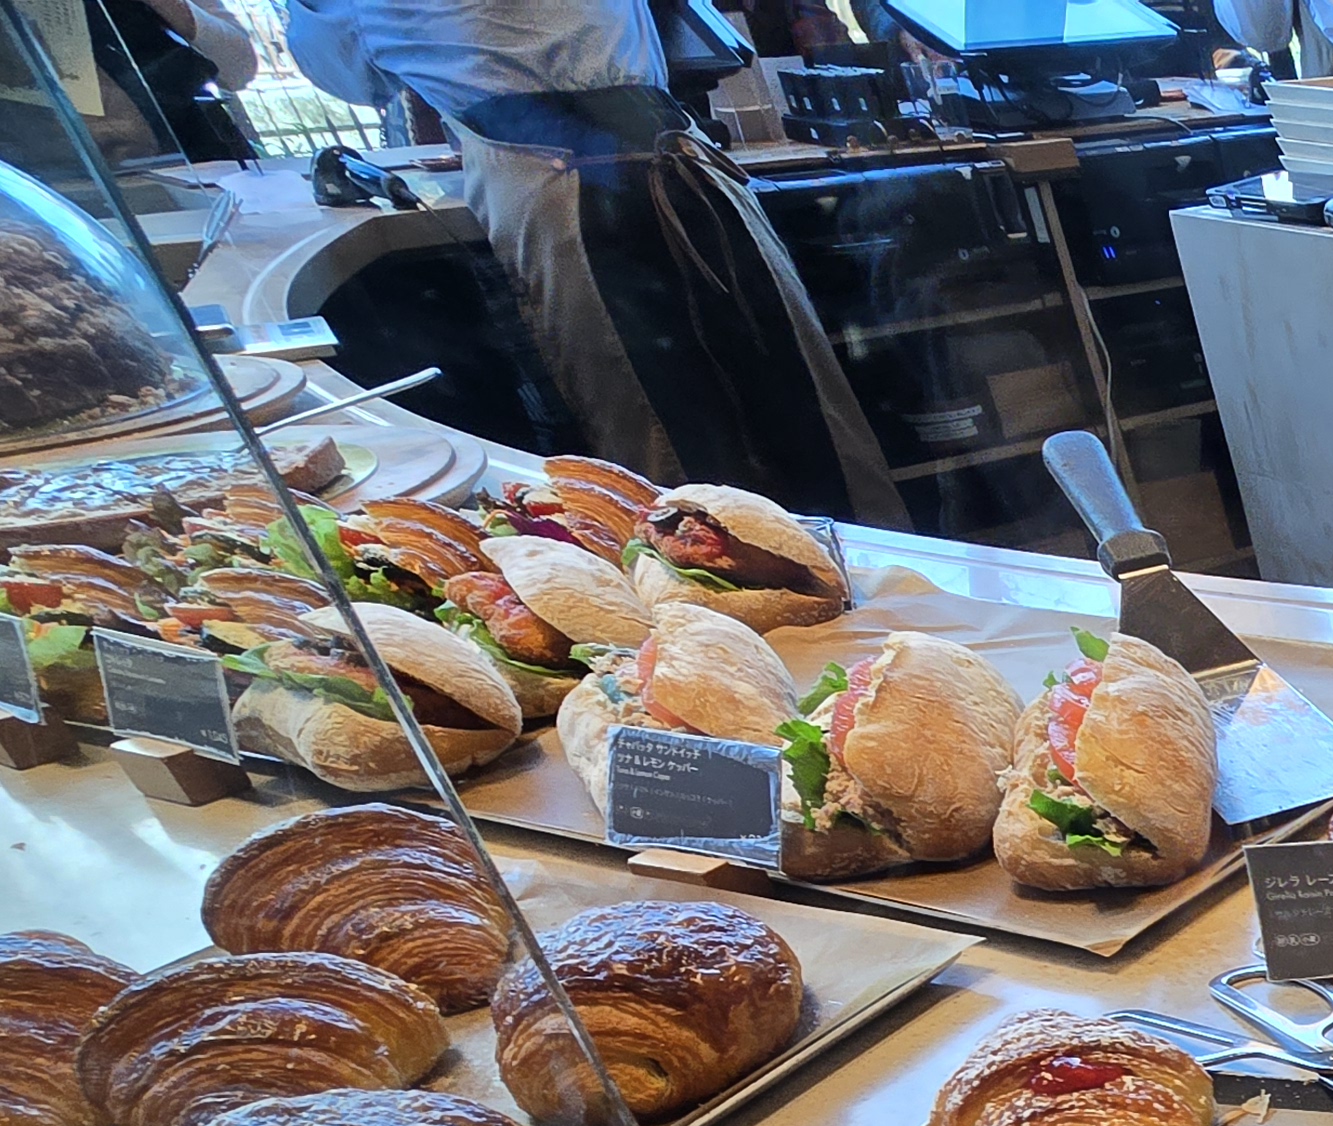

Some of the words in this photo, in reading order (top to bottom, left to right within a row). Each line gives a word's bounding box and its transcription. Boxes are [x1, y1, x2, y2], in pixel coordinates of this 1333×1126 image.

[642, 756, 666, 768] レモン
[1264, 875, 1300, 889] ジレラ
